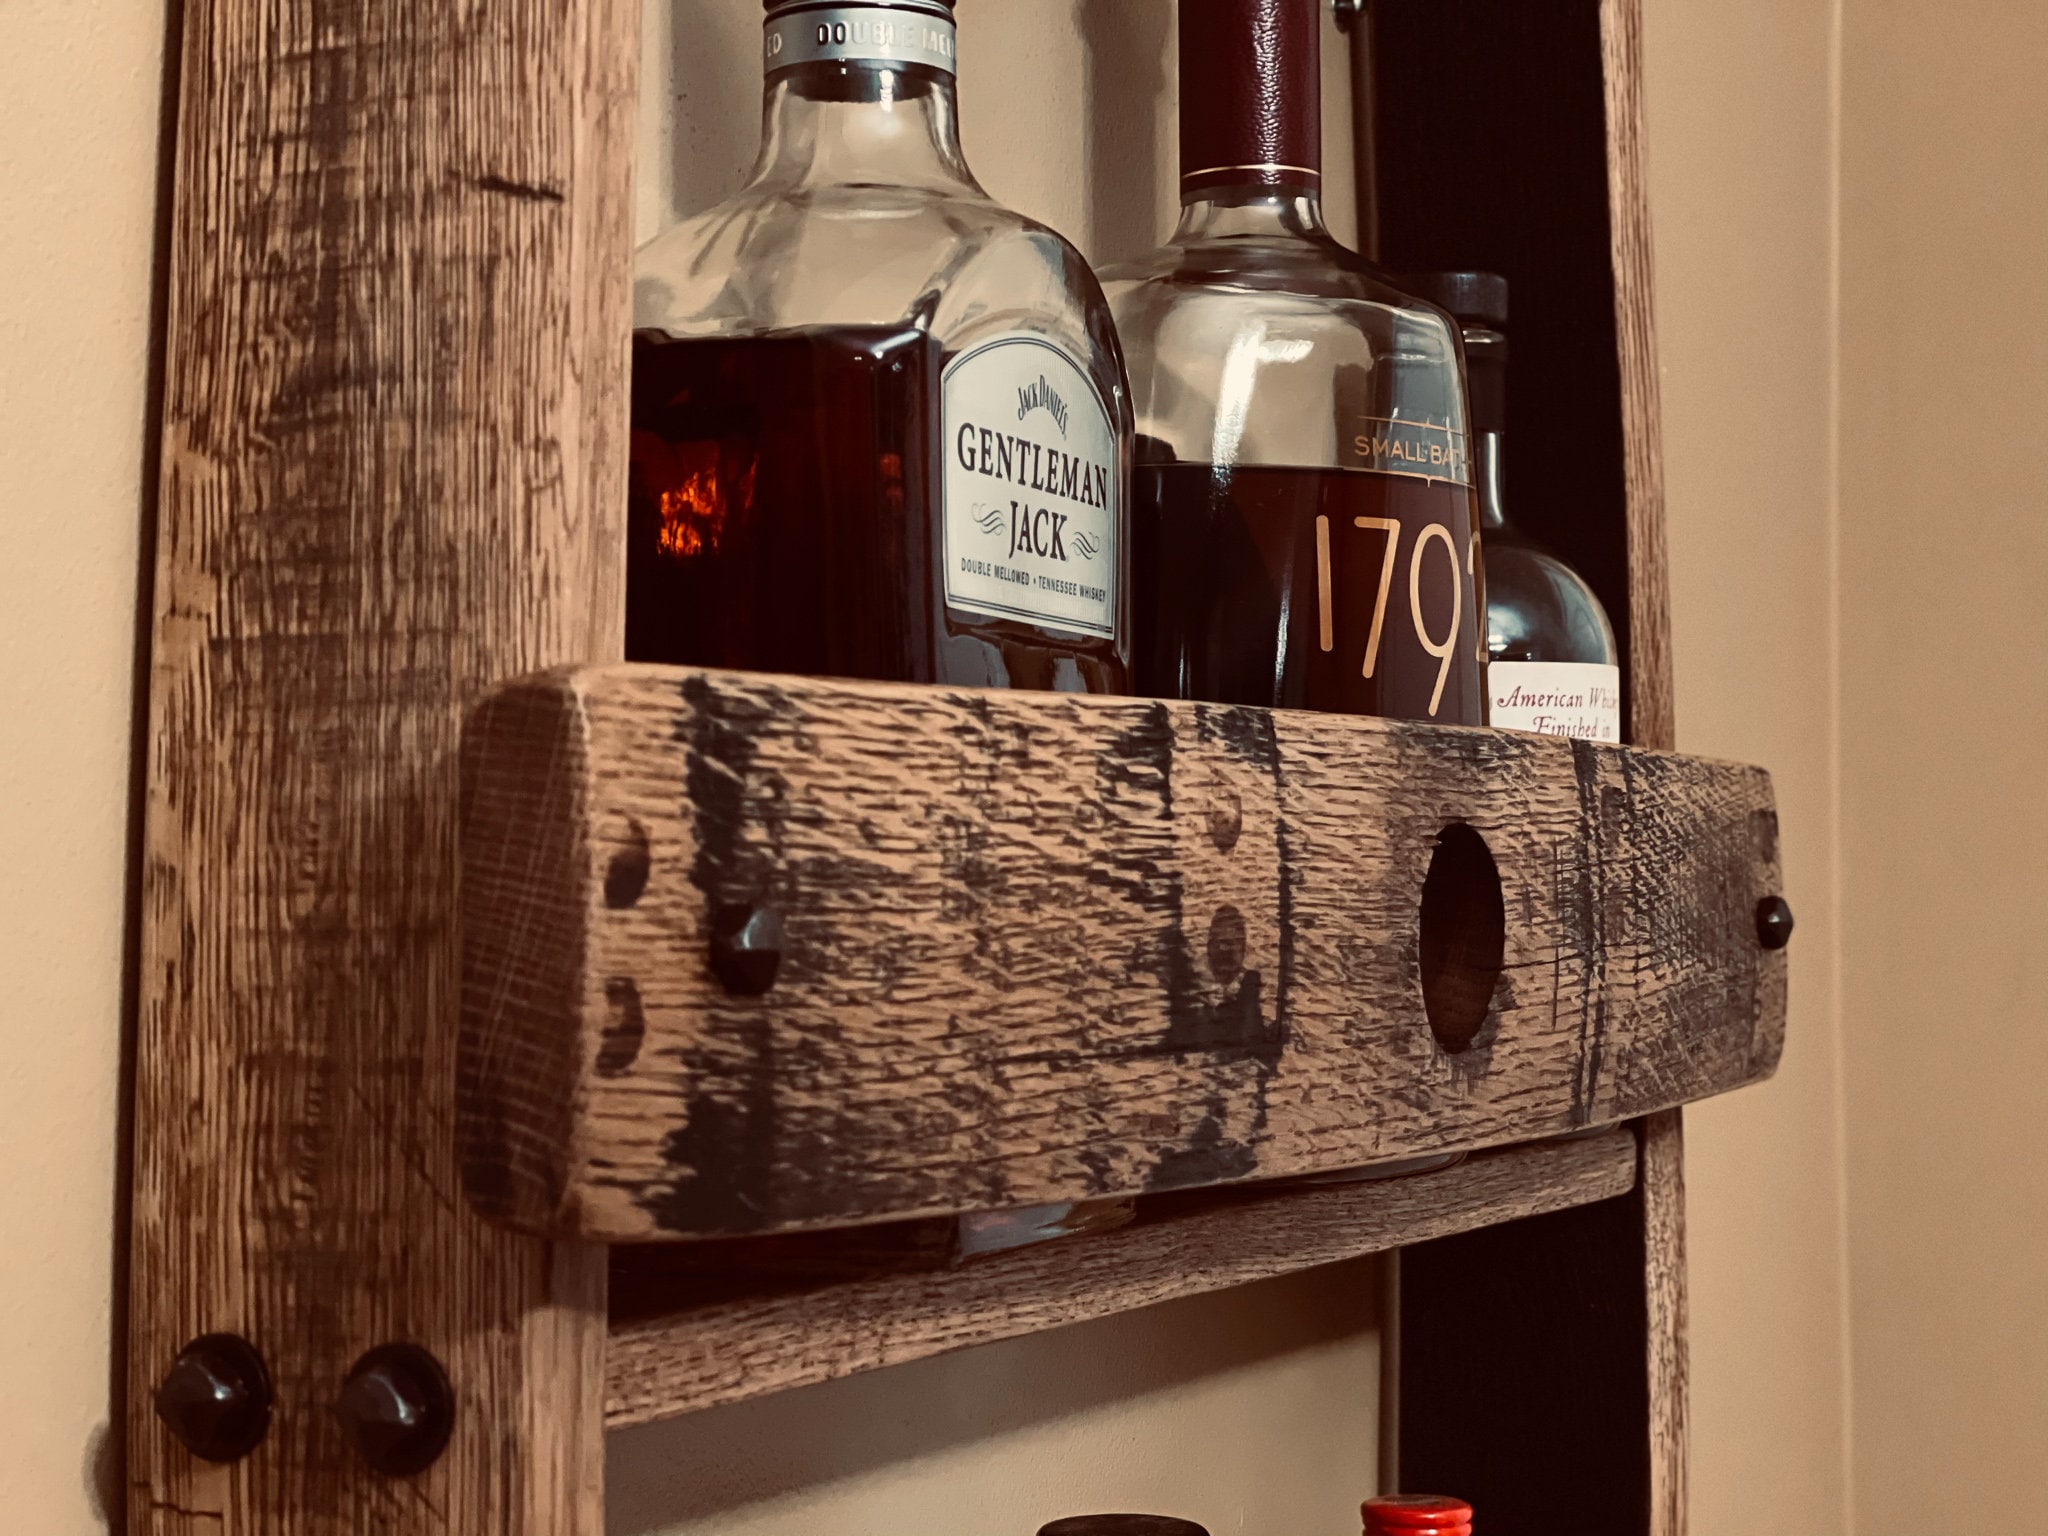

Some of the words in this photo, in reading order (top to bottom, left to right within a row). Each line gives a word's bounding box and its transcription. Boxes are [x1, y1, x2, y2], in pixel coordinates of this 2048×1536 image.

[816, 21, 915, 48] DOUBLE
[1017, 382, 1039, 421] JACK
[1354, 436, 1427, 463] SMALL
[956, 422, 1108, 512] GENTLEMAN
[1008, 500, 1068, 559] JACK
[961, 557, 991, 577] DOUBLE
[994, 565, 1030, 586] MELLOWED
[1038, 575, 1077, 596] TENNESSEE
[1079, 584, 1107, 603] WHISKEY
[1496, 685, 1584, 708] American
[1532, 715, 1599, 738] Finished
